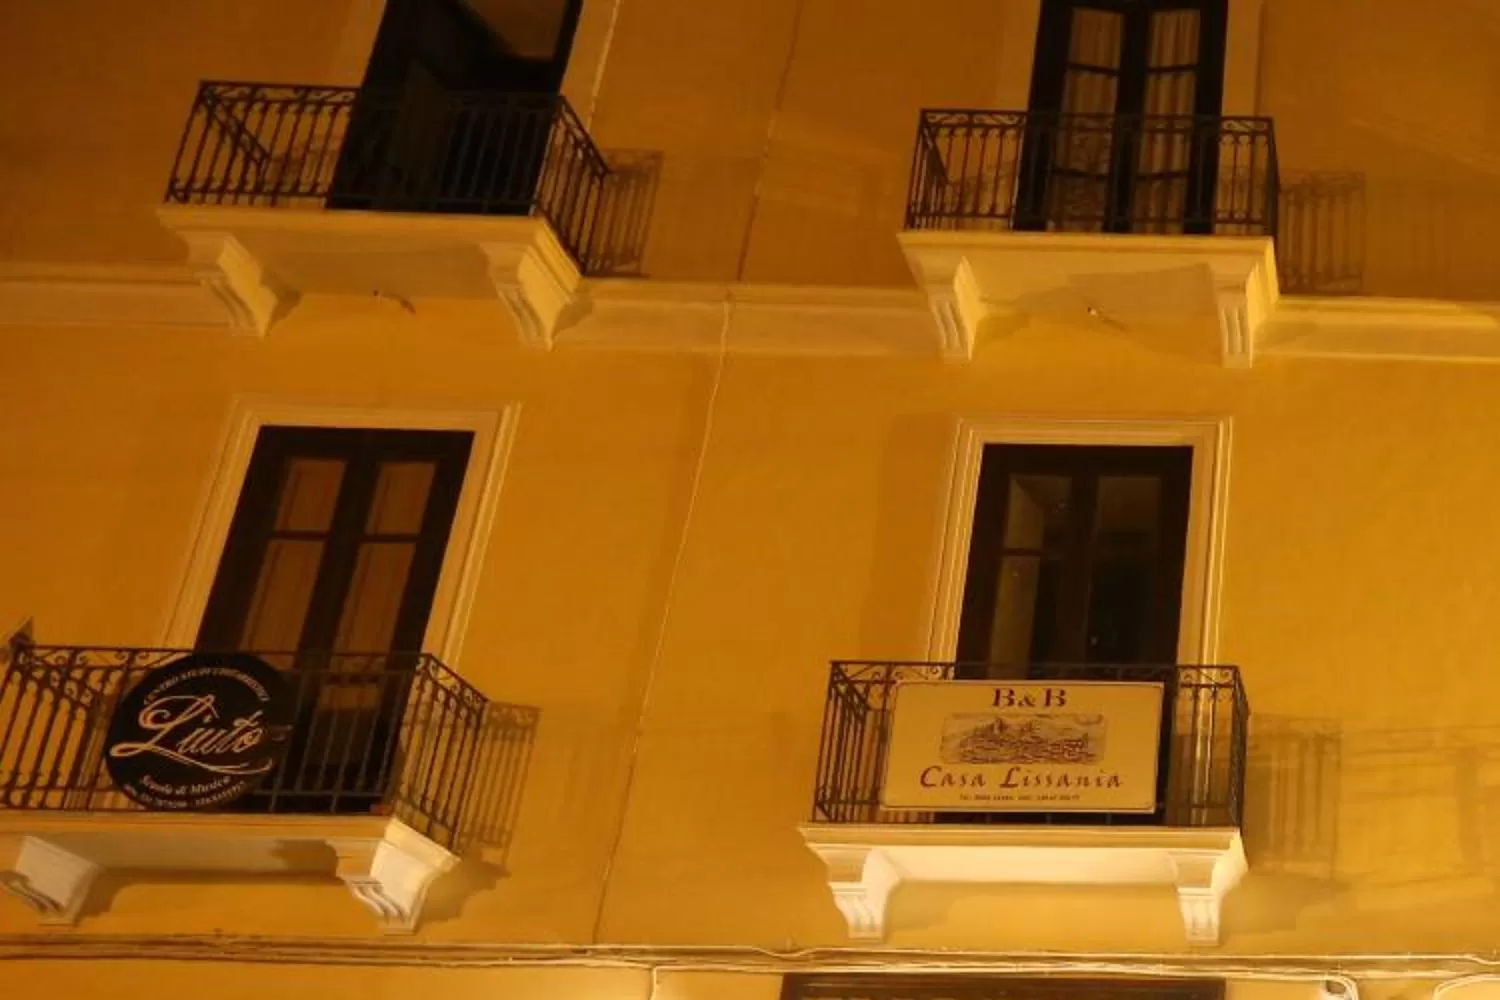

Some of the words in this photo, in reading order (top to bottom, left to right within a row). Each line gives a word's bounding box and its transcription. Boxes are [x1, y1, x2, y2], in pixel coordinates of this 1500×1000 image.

[992, 687, 1067, 708] B&B
[919, 765, 987, 789] Casa
[999, 767, 1123, 789] Lissania
